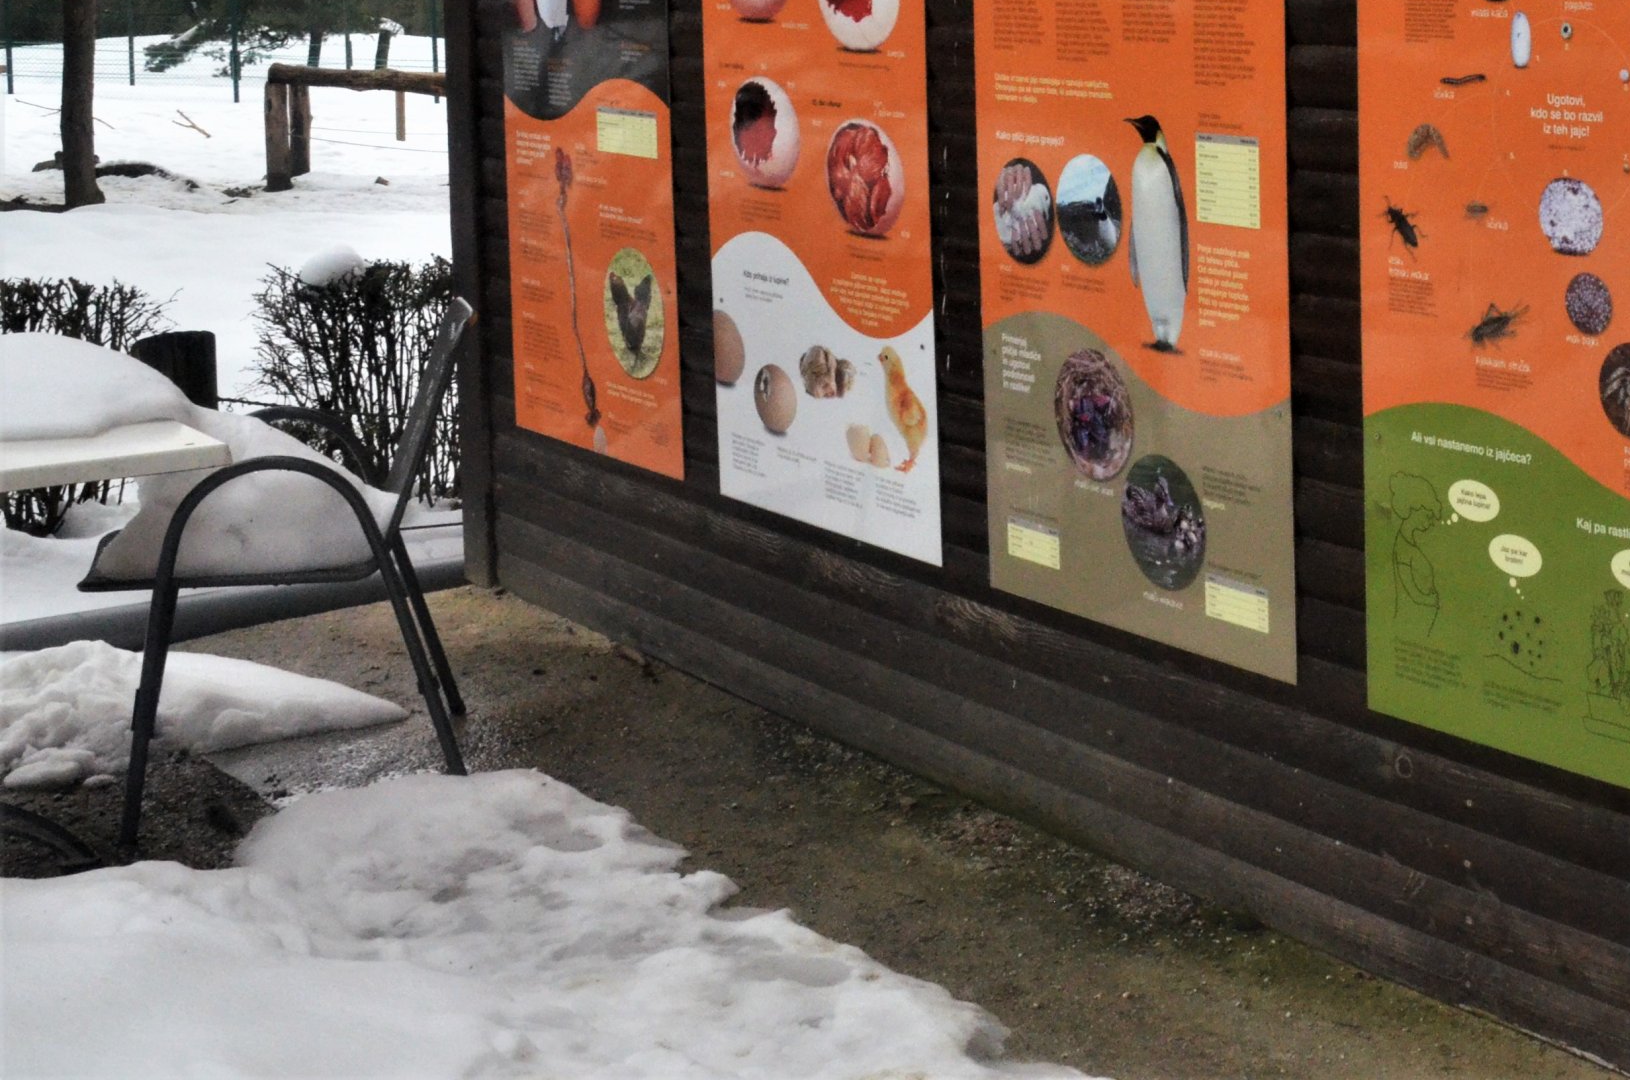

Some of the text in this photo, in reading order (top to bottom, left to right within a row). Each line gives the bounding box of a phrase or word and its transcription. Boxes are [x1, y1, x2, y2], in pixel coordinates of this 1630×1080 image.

[1547, 93, 1586, 108] Ugotovi,
[1530, 107, 1548, 119] kdo
[1550, 110, 1562, 120] se
[1563, 109, 1576, 121] bo
[1543, 123, 1590, 140] iz teh jajc!
[1411, 430, 1422, 443] Ali
[1423, 435, 1436, 446] vsi
[1437, 438, 1485, 457] nastanemo
[1486, 446, 1494, 458] iz
[1576, 517, 1592, 534] Kaj
[1593, 523, 1606, 535] pa
